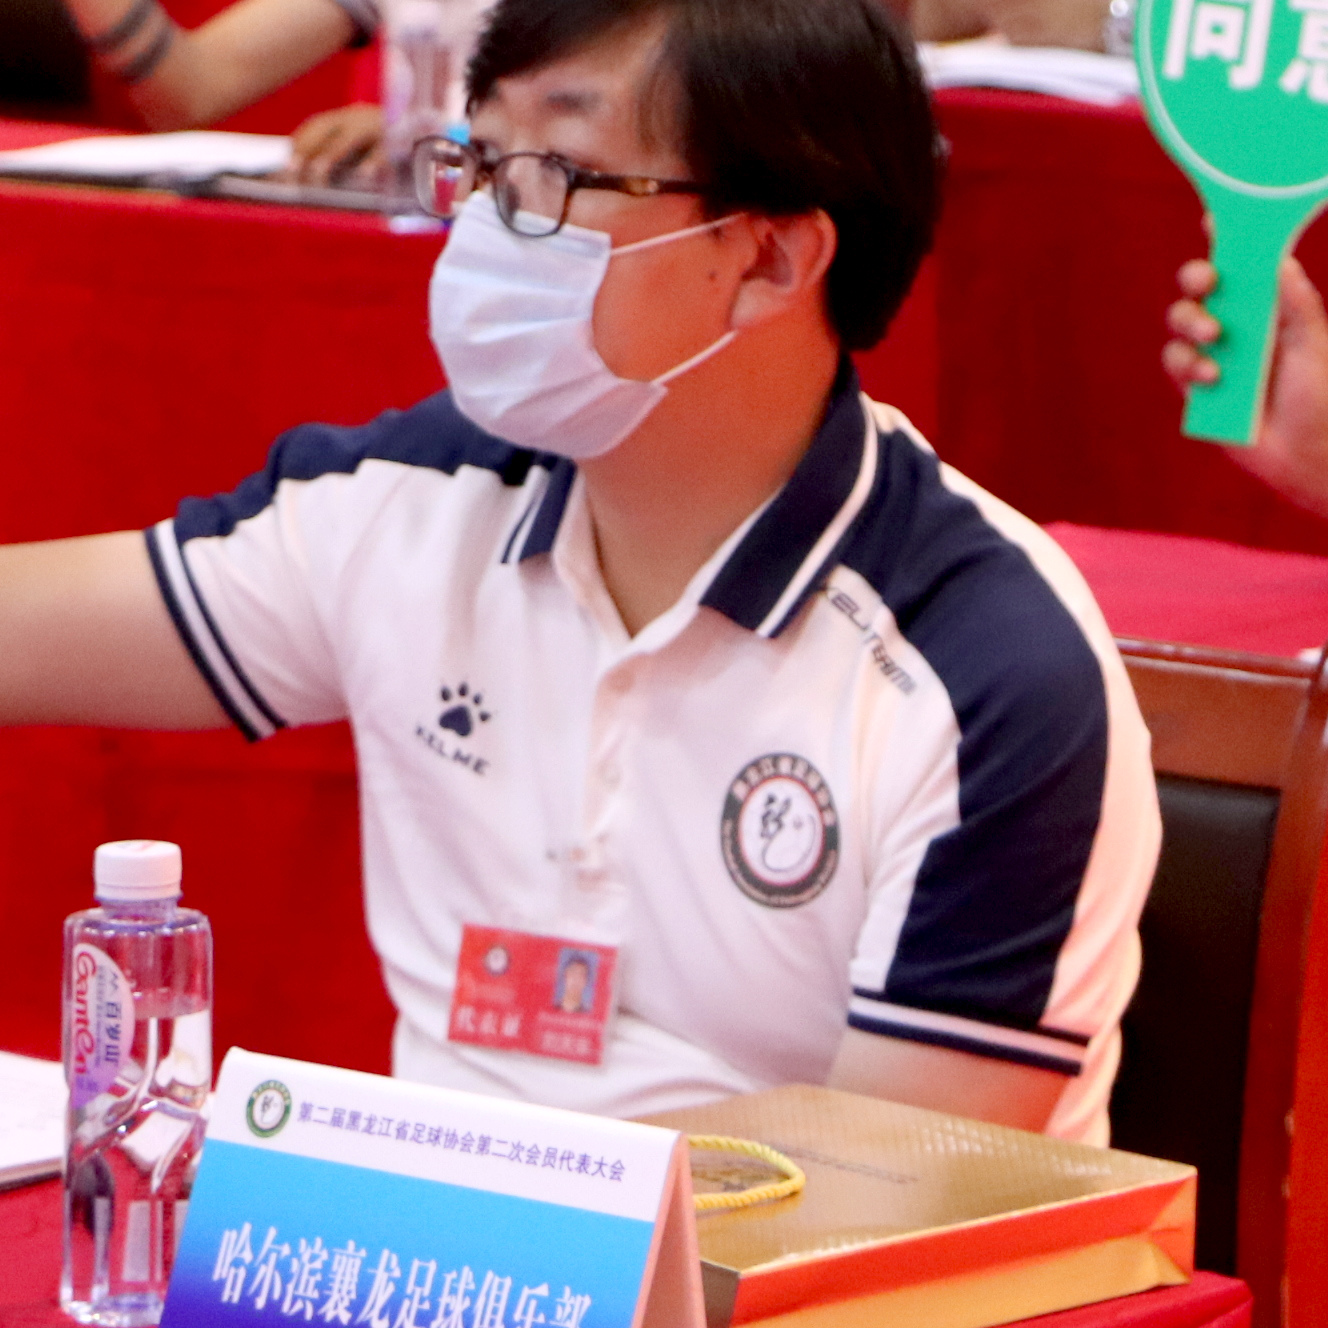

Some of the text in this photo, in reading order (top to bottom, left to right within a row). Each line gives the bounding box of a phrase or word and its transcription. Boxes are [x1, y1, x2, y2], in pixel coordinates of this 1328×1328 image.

[298, 1100, 626, 1182] 第二届黑龙江省足球协会第二次会员代表大会
[212, 1221, 592, 1328] 哈尔滨襄龙足球俱乐部
